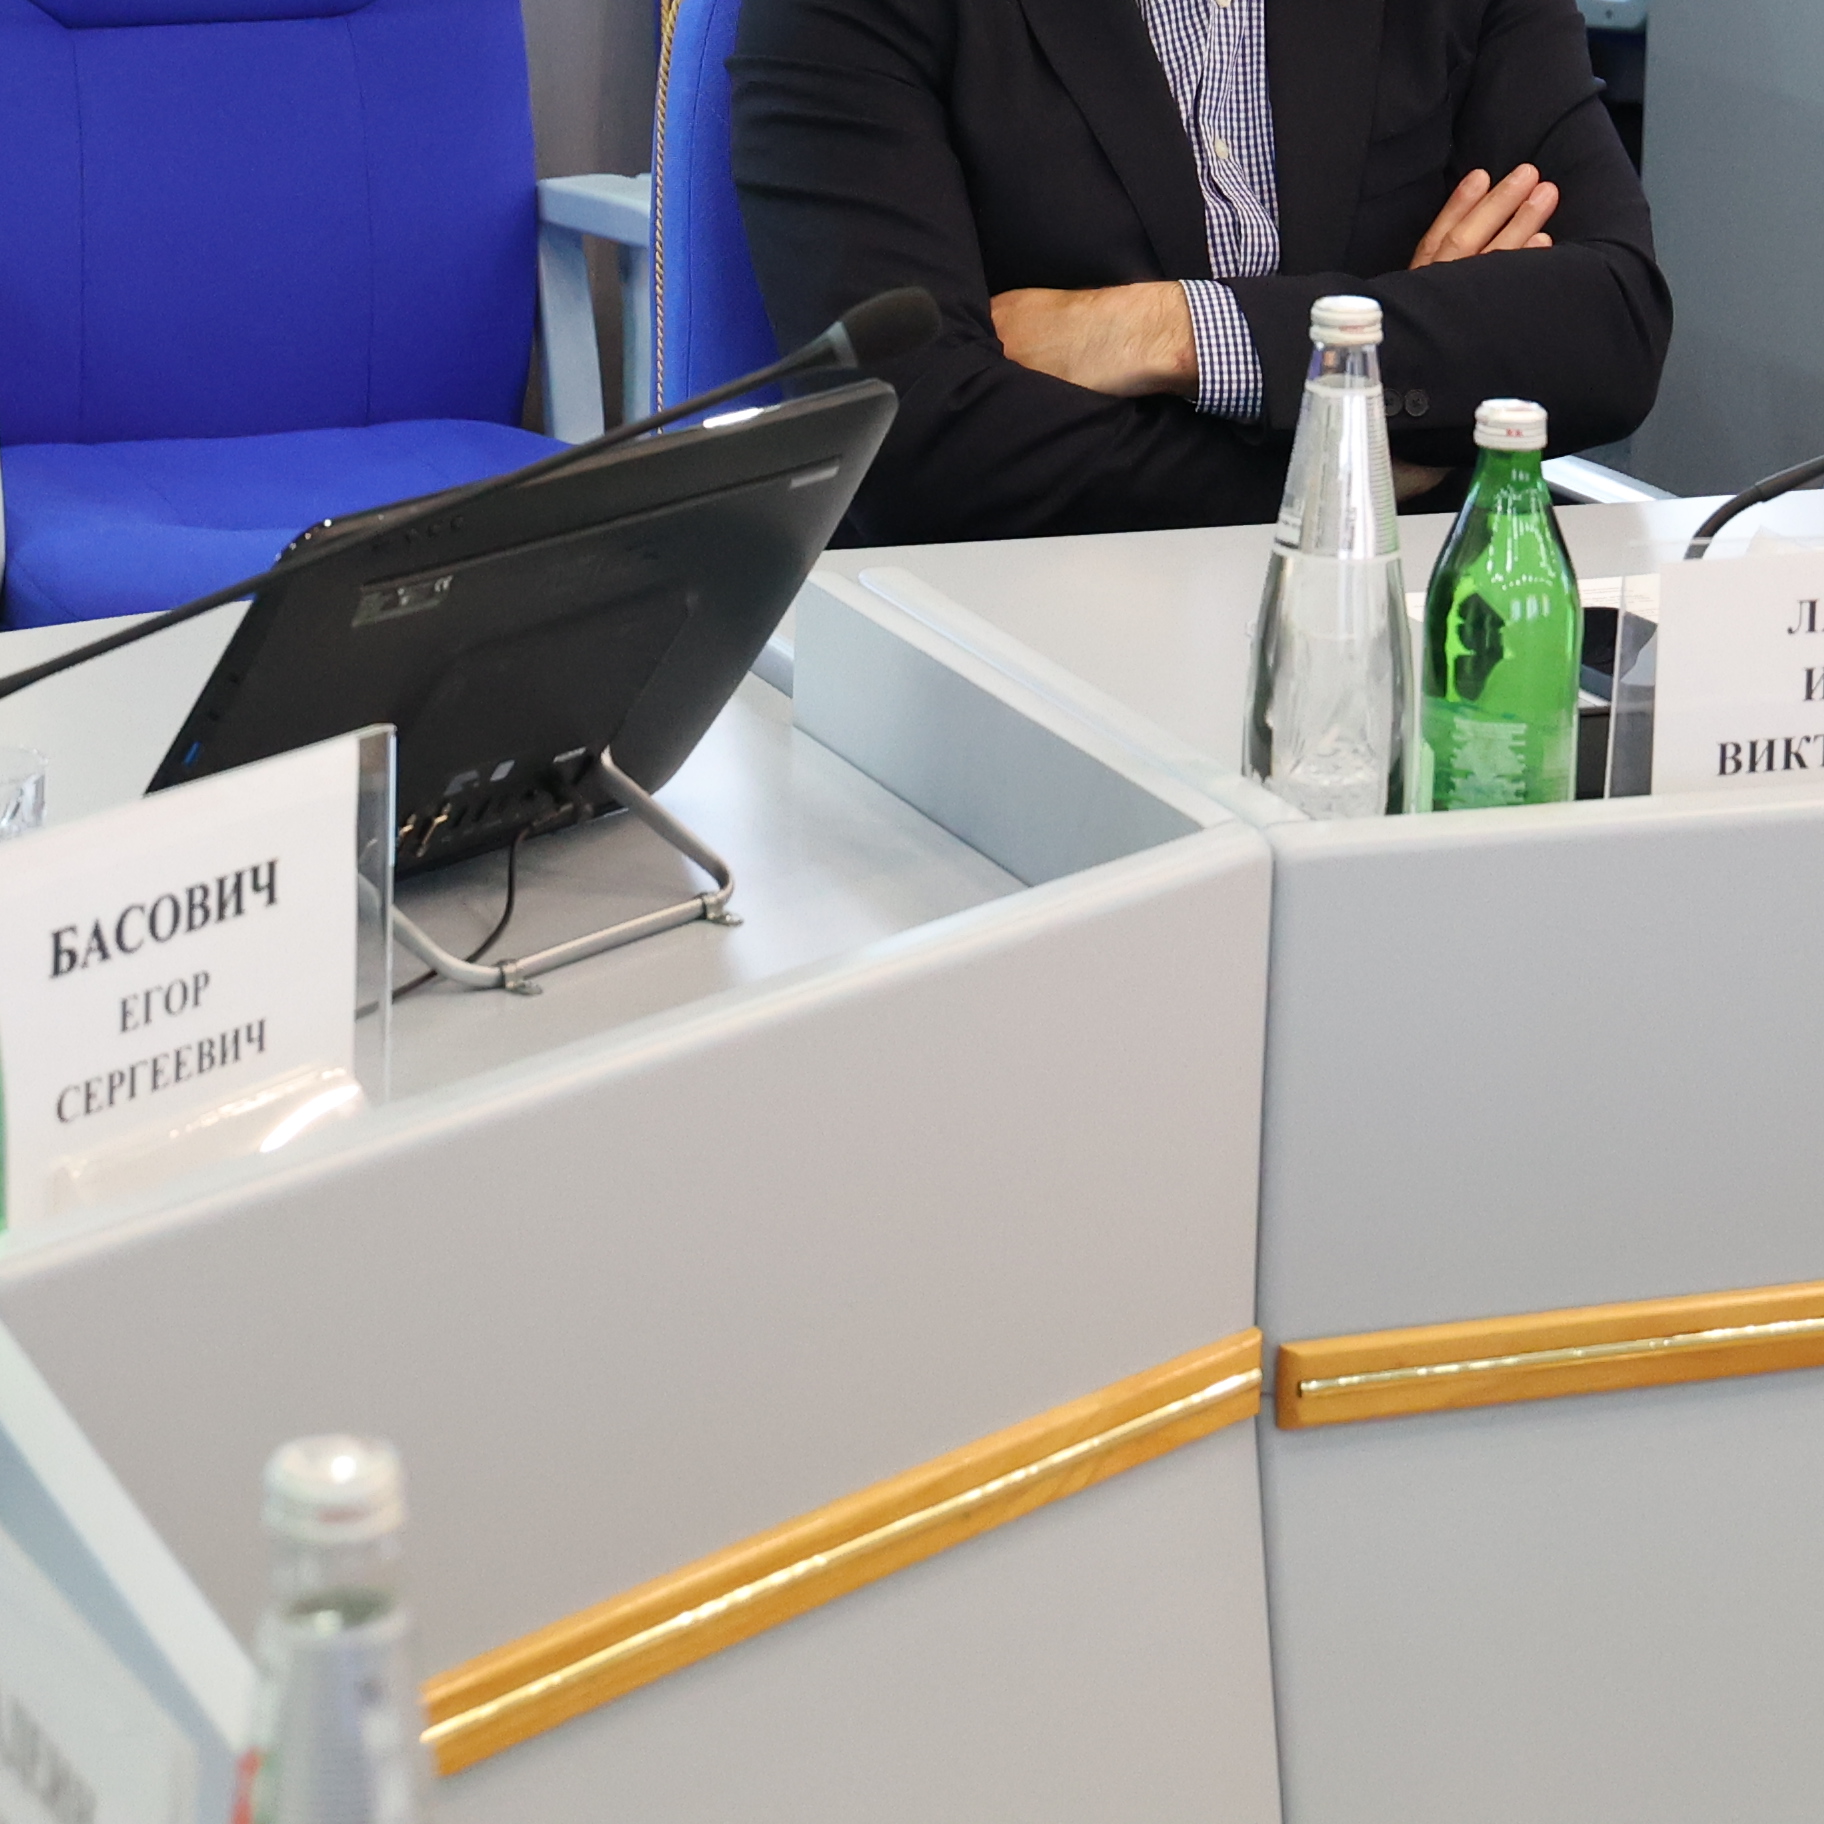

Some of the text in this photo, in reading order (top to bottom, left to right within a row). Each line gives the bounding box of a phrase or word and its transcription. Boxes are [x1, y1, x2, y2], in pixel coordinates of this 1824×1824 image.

[48, 858, 279, 979] БАСОВИЧ
[119, 970, 211, 1033] ЕГОР
[56, 1019, 267, 1124] СЕРГЕЕВИЧ
